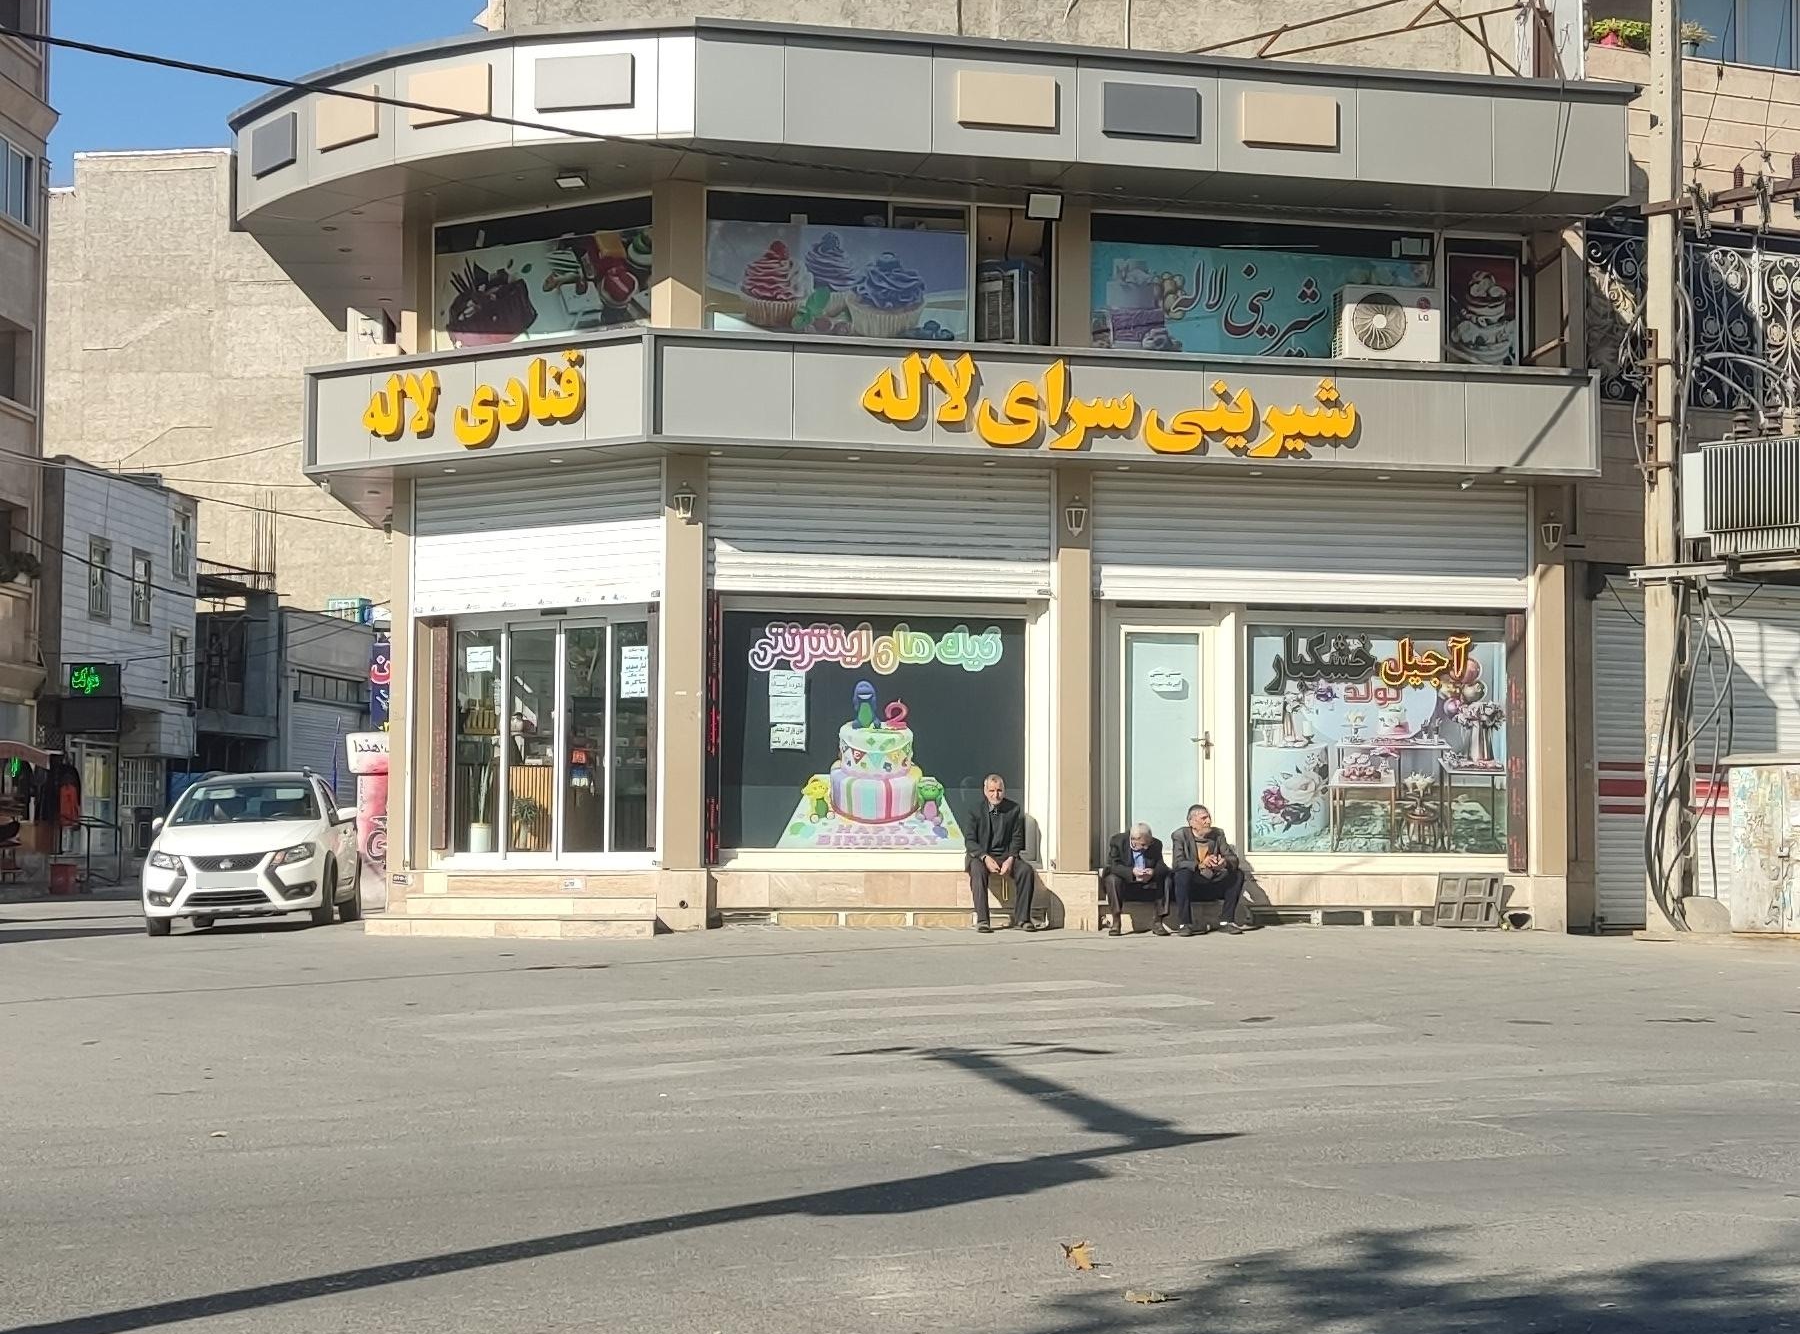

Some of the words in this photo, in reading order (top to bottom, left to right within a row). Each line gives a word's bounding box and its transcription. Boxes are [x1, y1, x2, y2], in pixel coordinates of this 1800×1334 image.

[1417, 314, 1430, 322] LG
[362, 369, 441, 437] لاله
[454, 349, 585, 446] قنادی
[861, 351, 978, 424] لاله
[977, 358, 1135, 452] سرای
[1144, 376, 1358, 458] شیرینی
[1380, 635, 1473, 687] آجیل
[816, 834, 939, 846] BIRTHDAY
[836, 824, 917, 835] HAPPY
